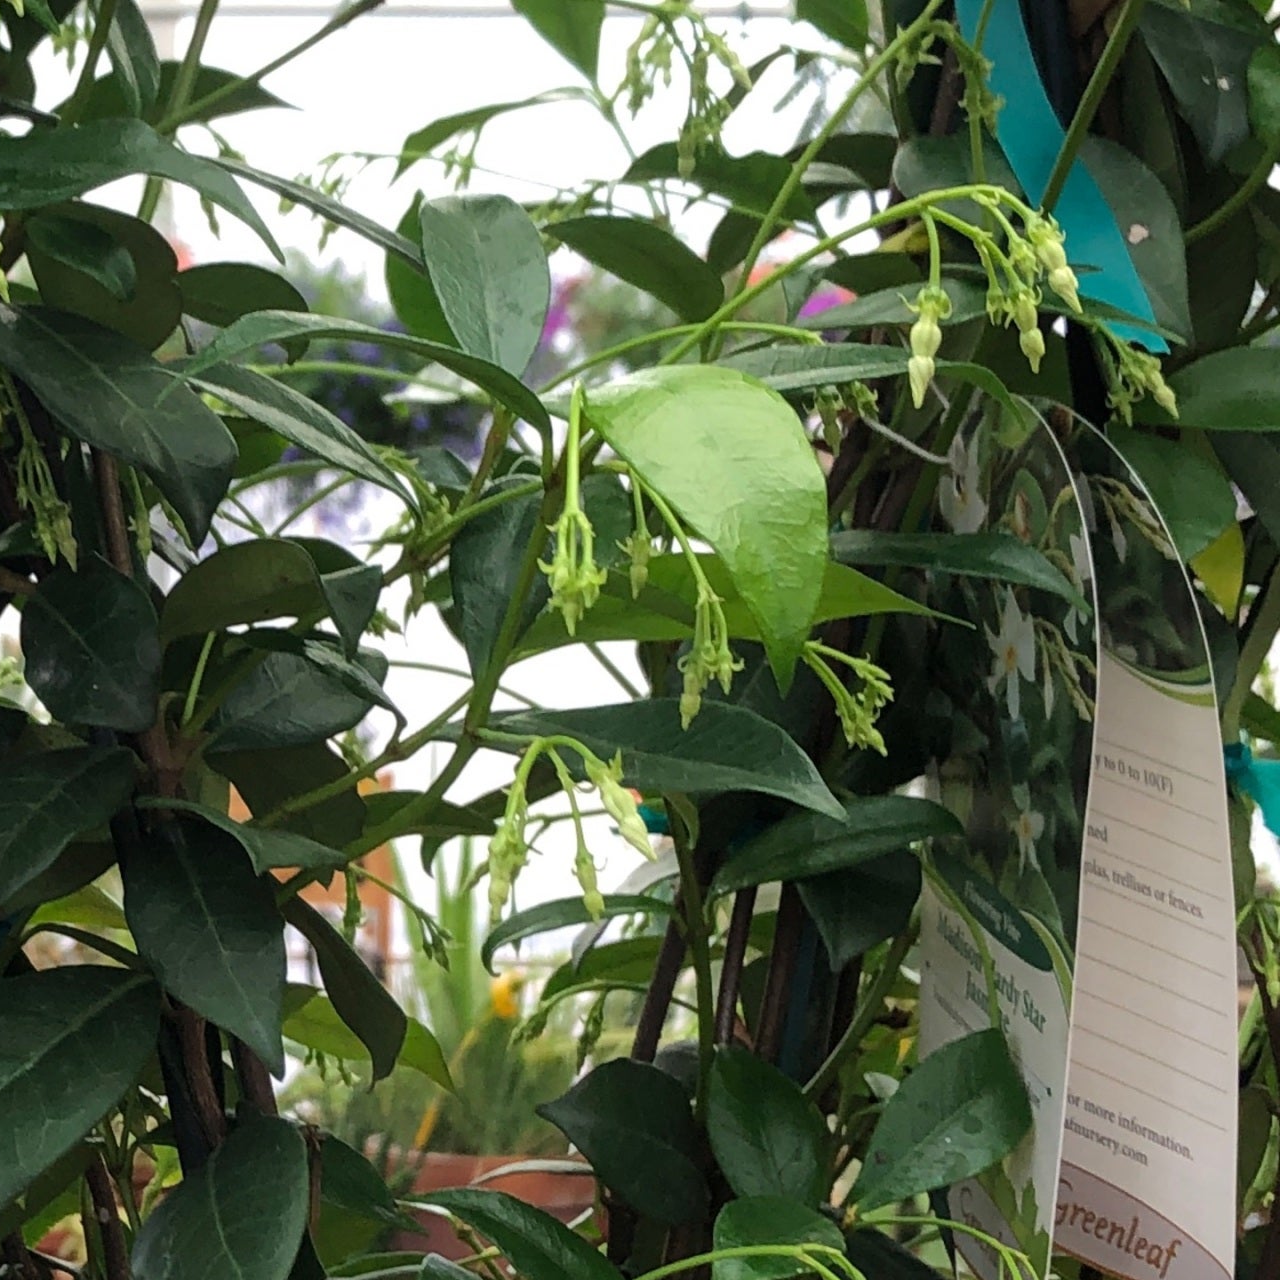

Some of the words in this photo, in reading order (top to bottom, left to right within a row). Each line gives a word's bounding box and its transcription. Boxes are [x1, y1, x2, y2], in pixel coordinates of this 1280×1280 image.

[1023, 990, 1047, 1034] Star
[1084, 1099, 1116, 1124] more
[1118, 1112, 1194, 1161] information.
